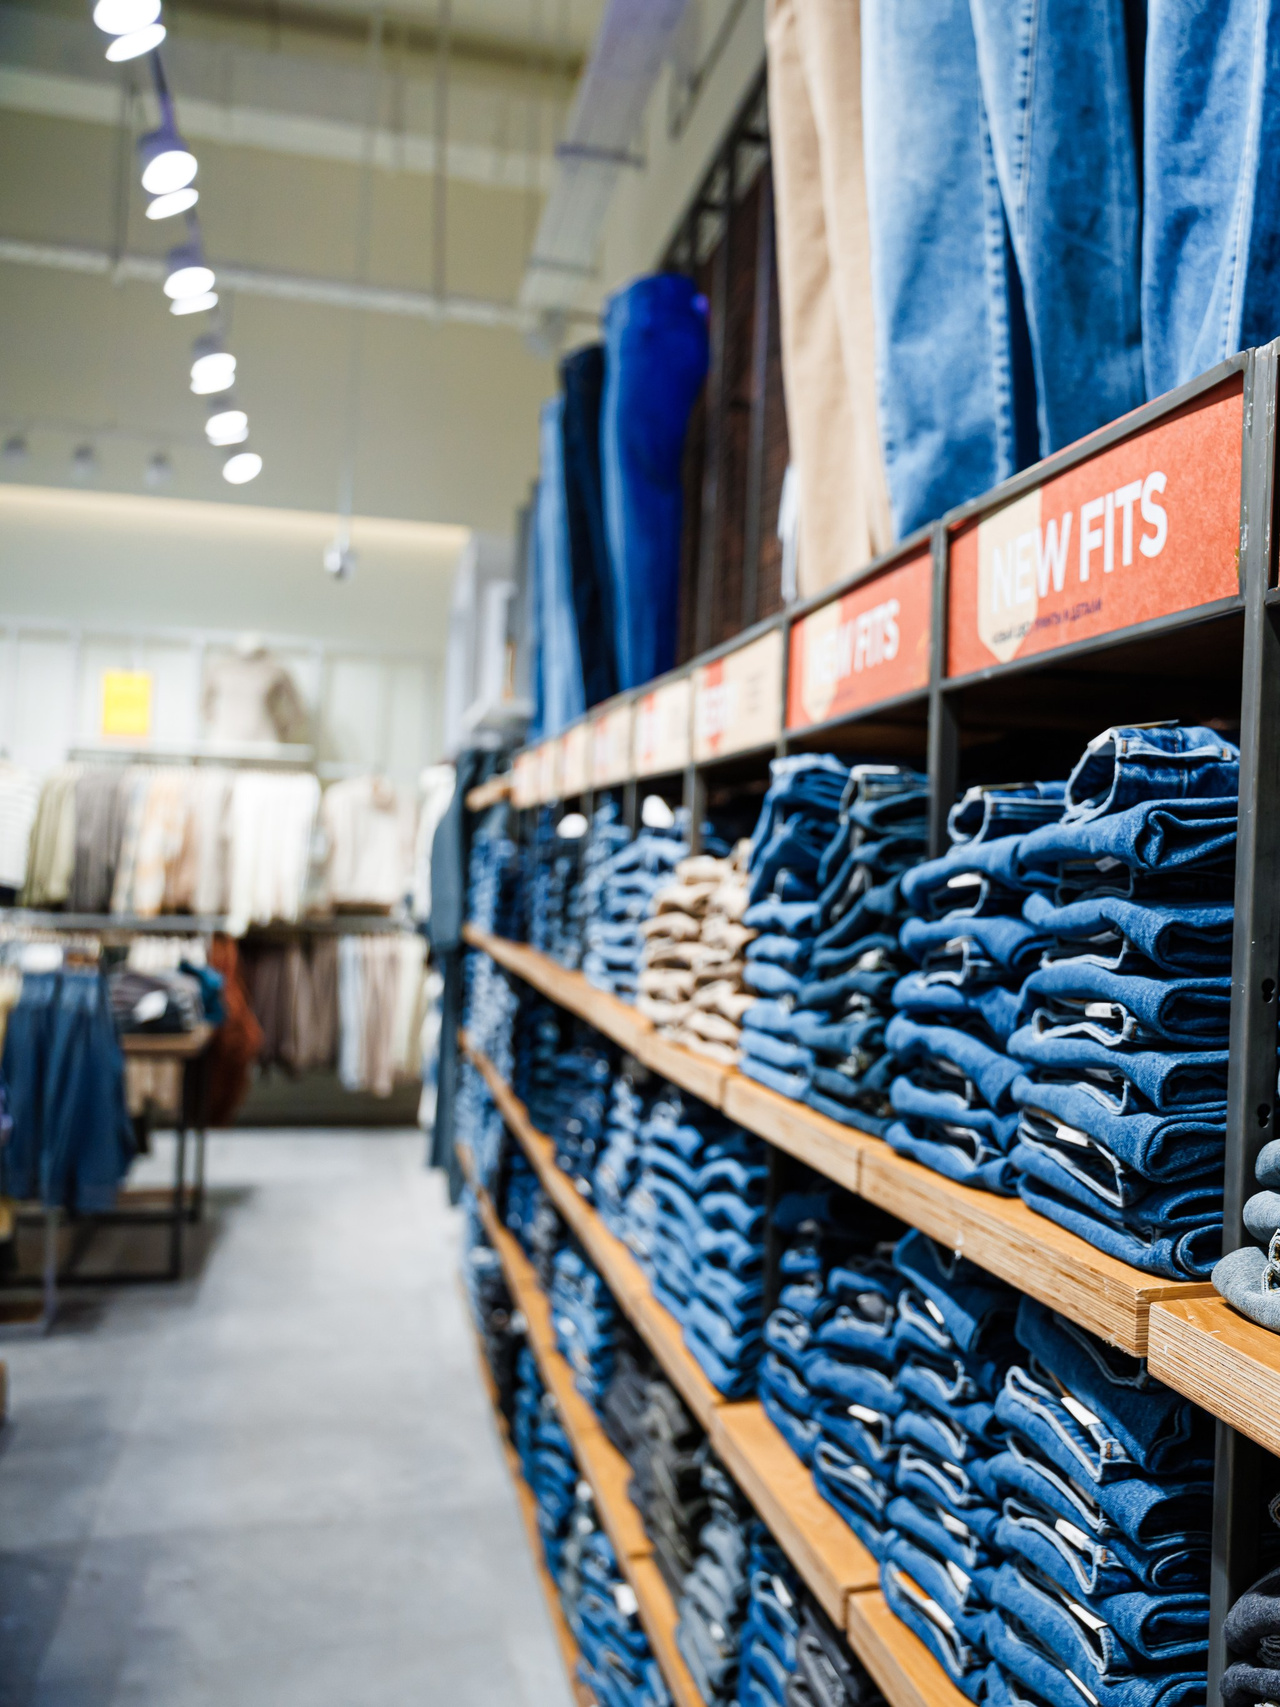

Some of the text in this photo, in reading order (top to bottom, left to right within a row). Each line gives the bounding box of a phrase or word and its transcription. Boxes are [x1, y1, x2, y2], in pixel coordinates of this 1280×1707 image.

[992, 471, 1168, 615] NEW FITS
[853, 598, 901, 674] FITS
